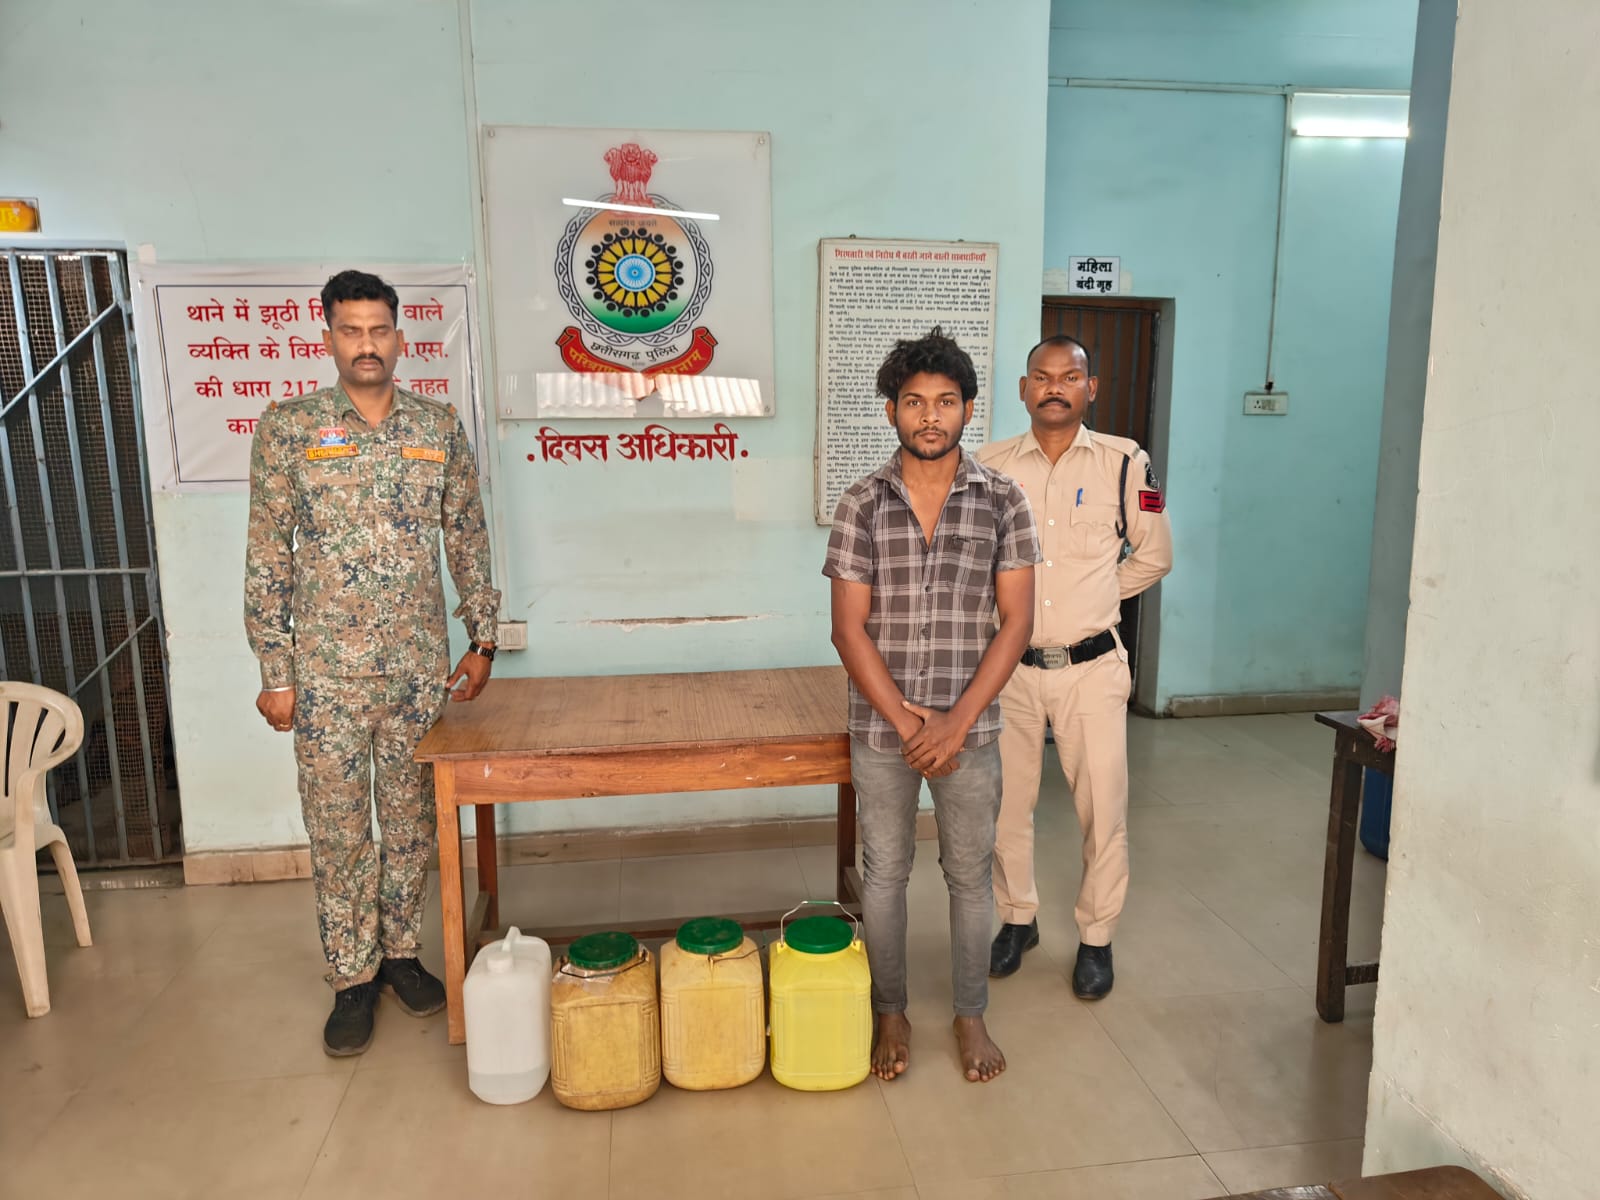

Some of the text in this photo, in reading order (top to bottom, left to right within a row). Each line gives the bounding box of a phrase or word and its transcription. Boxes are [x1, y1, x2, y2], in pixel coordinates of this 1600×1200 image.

[1077, 258, 1113, 274] महिला
[1076, 276, 1113, 293] बंदी गृह
[187, 298, 224, 322] थाने
[233, 298, 250, 321] में
[258, 299, 300, 330] झूठी
[402, 297, 443, 321] वाले
[188, 336, 250, 360] व्यक्ति
[258, 336, 280, 359] के
[646, 344, 679, 362] पुलिस
[194, 376, 223, 398] की
[232, 381, 271, 398] धारा
[282, 380, 318, 397] 217
[409, 378, 449, 397] तहत
